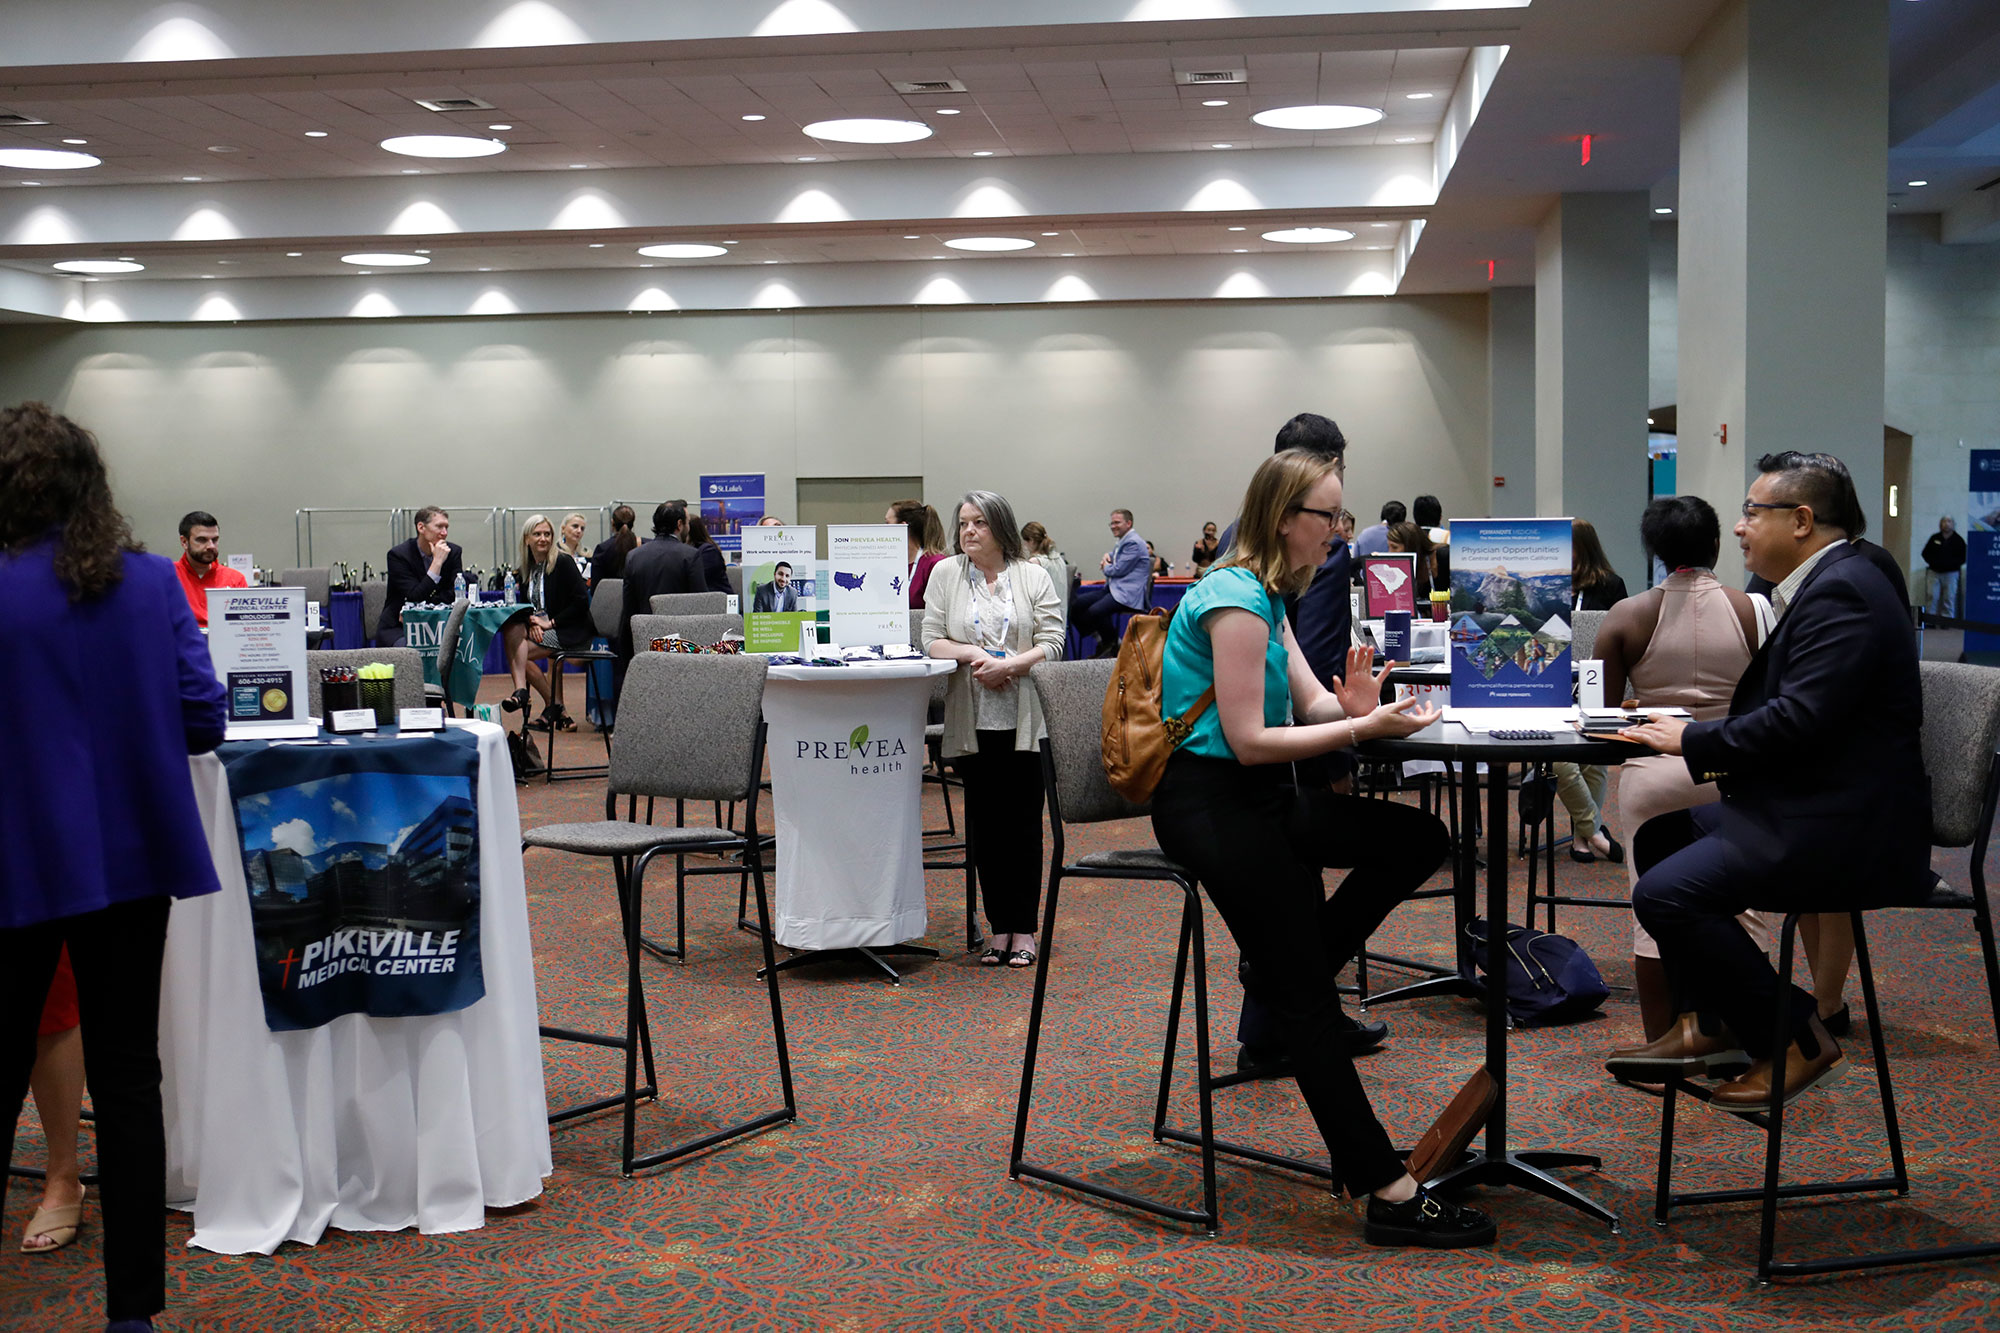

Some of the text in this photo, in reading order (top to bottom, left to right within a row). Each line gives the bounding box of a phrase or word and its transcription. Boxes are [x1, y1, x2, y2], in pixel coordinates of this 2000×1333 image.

[1461, 546, 1560, 555] Physician Opportunities
[230, 597, 289, 606] PIKEVILLE
[728, 599, 737, 607] 14
[309, 607, 319, 615] 15
[406, 620, 463, 647] HM
[806, 627, 815, 637] 11
[1586, 669, 1598, 685] 2
[796, 738, 907, 760] PREVEA
[850, 761, 902, 775] health
[301, 929, 461, 971] PIKEVILLE
[298, 956, 456, 990] MEDICAL CENTER
